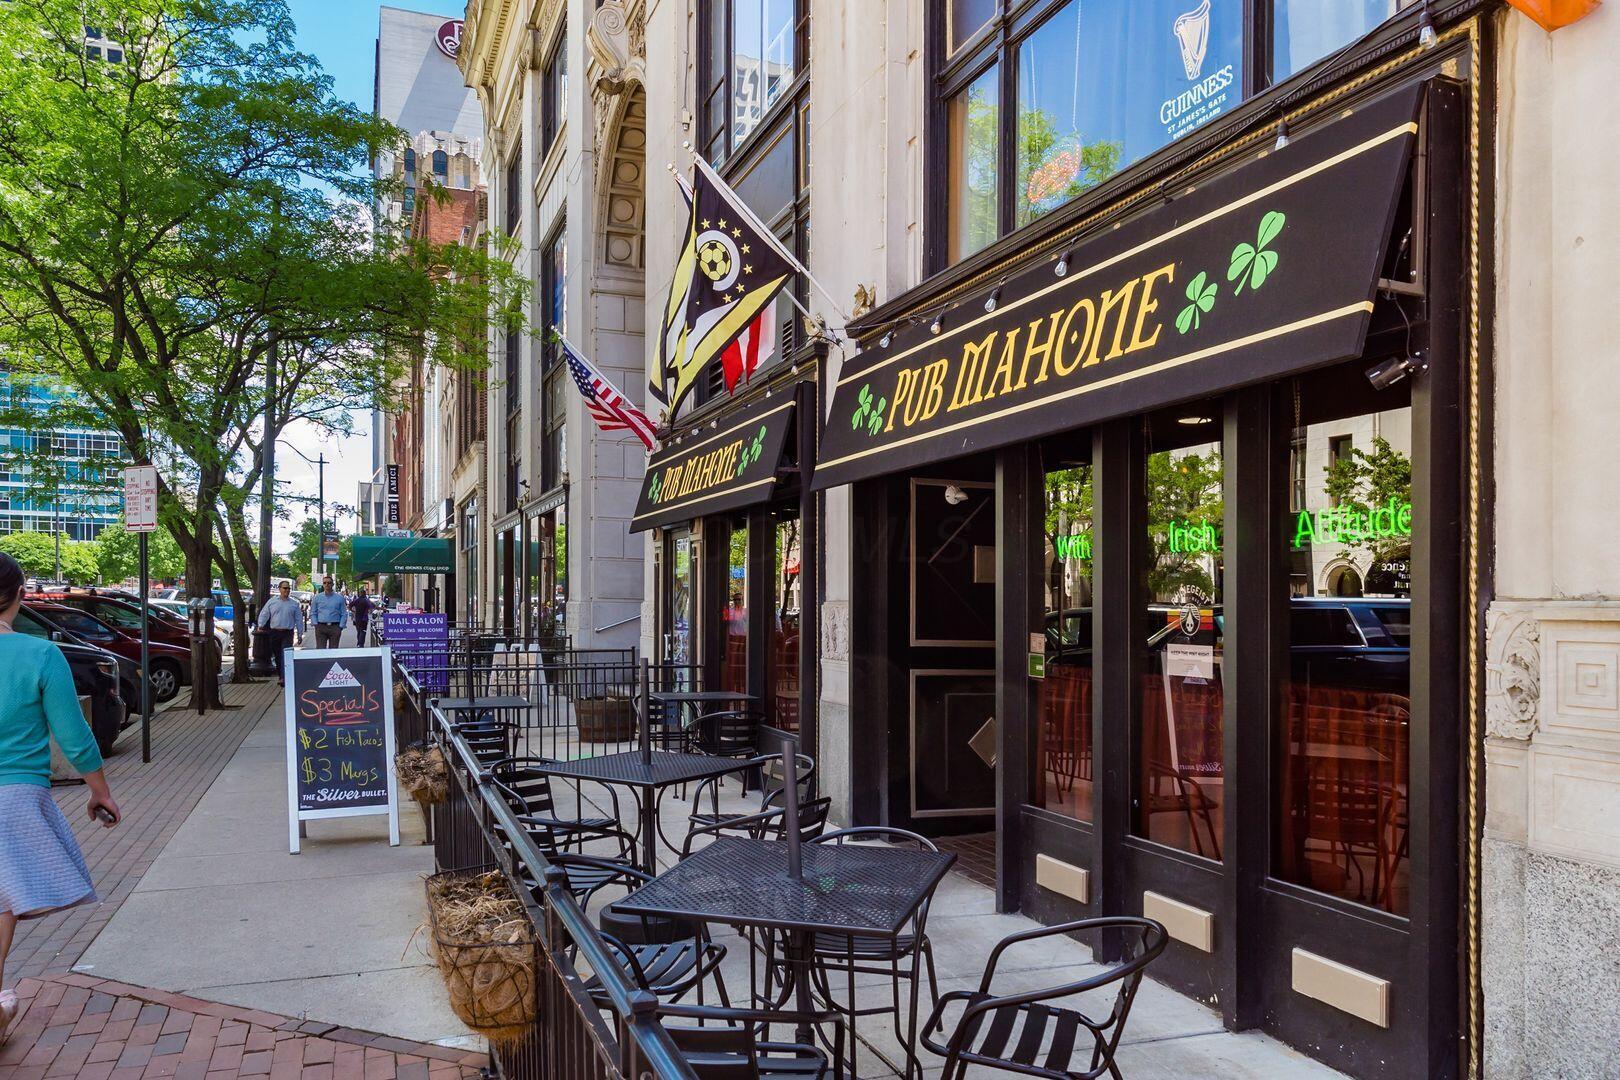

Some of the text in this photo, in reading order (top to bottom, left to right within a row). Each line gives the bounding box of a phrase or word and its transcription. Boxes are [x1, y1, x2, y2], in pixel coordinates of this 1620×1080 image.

[1160, 64, 1233, 125] GUINNESS
[1167, 92, 1226, 134] ST JAMES'S GATE
[884, 263, 1176, 433] PUB MAHONE
[657, 439, 743, 504] PUB MAHONE
[389, 467, 398, 521] DUE AMICI
[1169, 519, 1221, 553] Irish
[1294, 496, 1411, 548] Attitude
[388, 616, 444, 625] NAIL SALON
[325, 670, 354, 680] Coors
[301, 684, 379, 723] Specials
[298, 727, 329, 750] $2
[336, 728, 354, 746] Fish
[301, 756, 333, 785] $3
[316, 788, 361, 802] Silver
